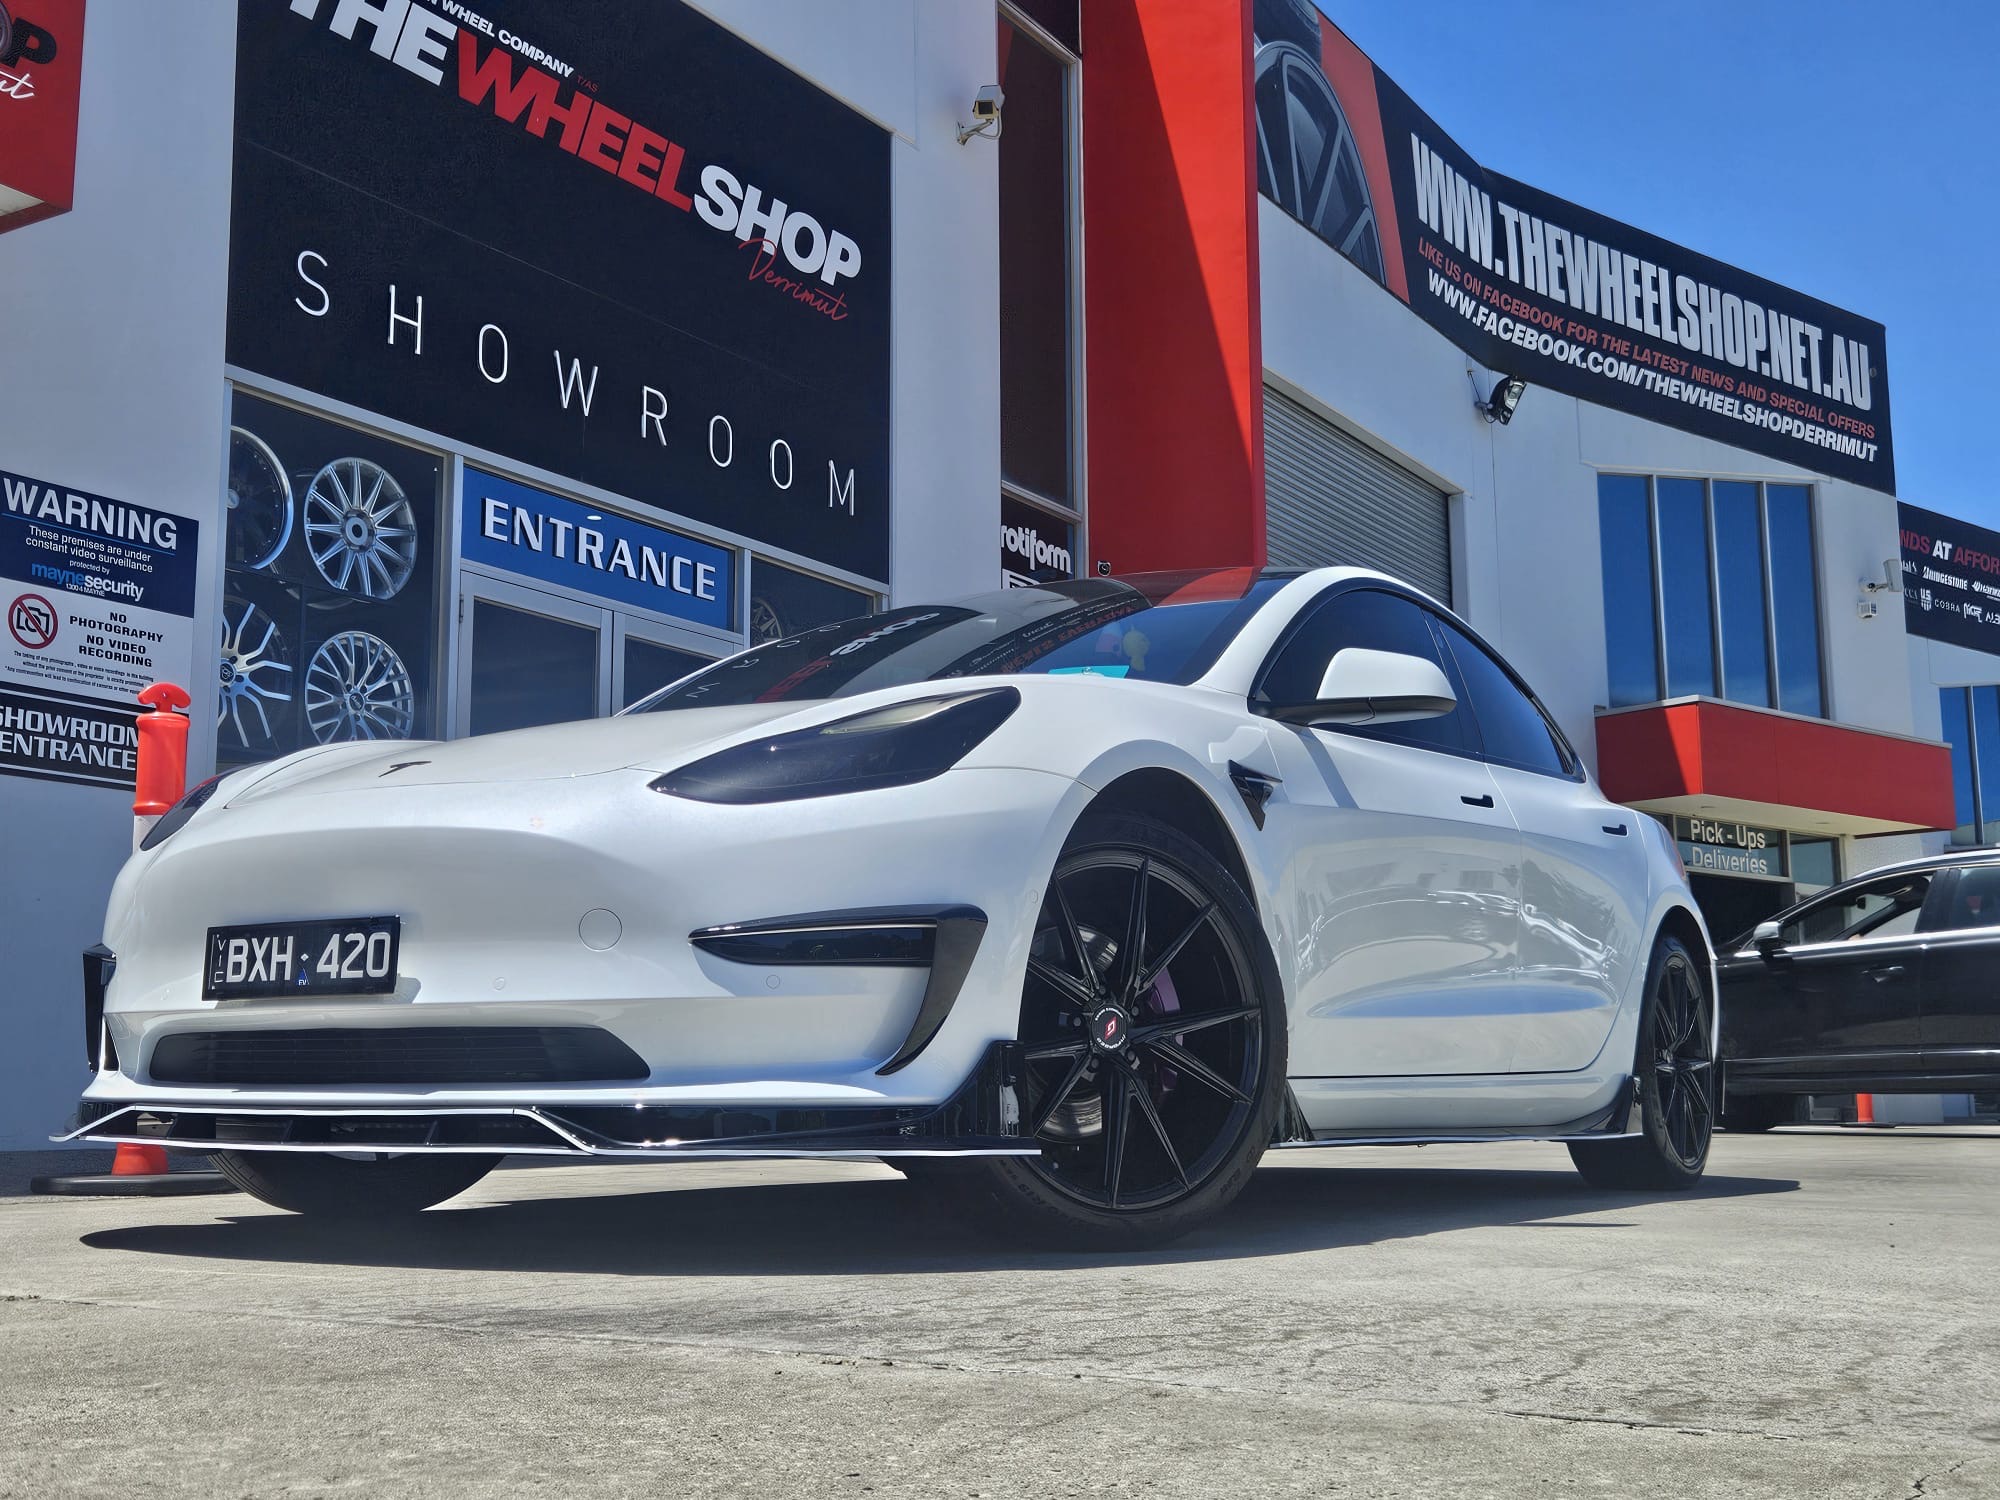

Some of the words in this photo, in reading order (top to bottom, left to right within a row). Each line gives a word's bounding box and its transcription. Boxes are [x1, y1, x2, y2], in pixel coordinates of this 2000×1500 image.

[441, 0, 495, 37] WHEEL
[498, 29, 574, 78] COMPANY
[738, 237, 849, 322] Derrimut
[1410, 131, 1872, 412] WWW.THEWHEELSHOP.NET.AU
[1418, 236, 1443, 270] LIKE
[1445, 256, 1461, 284] US
[1463, 272, 1483, 297] ON
[1483, 283, 1565, 334] FACEBOOK
[1566, 321, 1598, 346] FOR
[1601, 333, 1630, 357] THE
[1632, 345, 1689, 377] LATEST
[1691, 364, 1734, 393] NEWS
[1736, 381, 1767, 403] AND
[1769, 392, 1825, 423] SPECIAL
[1827, 411, 1876, 439] OFFERS
[295, 250, 856, 517] SHOWROOM
[1428, 267, 1878, 463] WWW.FACEBOOK.COM/THEWHEELSHOPDERRIMUT
[3, 477, 178, 550] WARNING
[25, 537, 69, 554] constant
[70, 546, 96, 560] video
[99, 551, 153, 573] surveillance
[28, 525, 59, 541] These
[61, 533, 105, 552] premises
[107, 545, 122, 556] are
[124, 549, 152, 563] under
[483, 497, 717, 601] ENTRANCE
[1001, 524, 1072, 575] rotiform
[1932, 539, 1953, 561] AT
[69, 559, 100, 573] protected
[101, 564, 111, 576] by
[69, 615, 164, 643] PHOTOGRAPHY
[109, 612, 127, 624] NO
[78, 645, 153, 668] RECORDING
[86, 634, 104, 647] NO
[108, 638, 147, 655] VIDEO
[0, 730, 137, 771] ENTRANCE
[1692, 846, 1768, 874] Deliveries
[226, 935, 294, 983] BXH
[316, 931, 391, 979] 420
